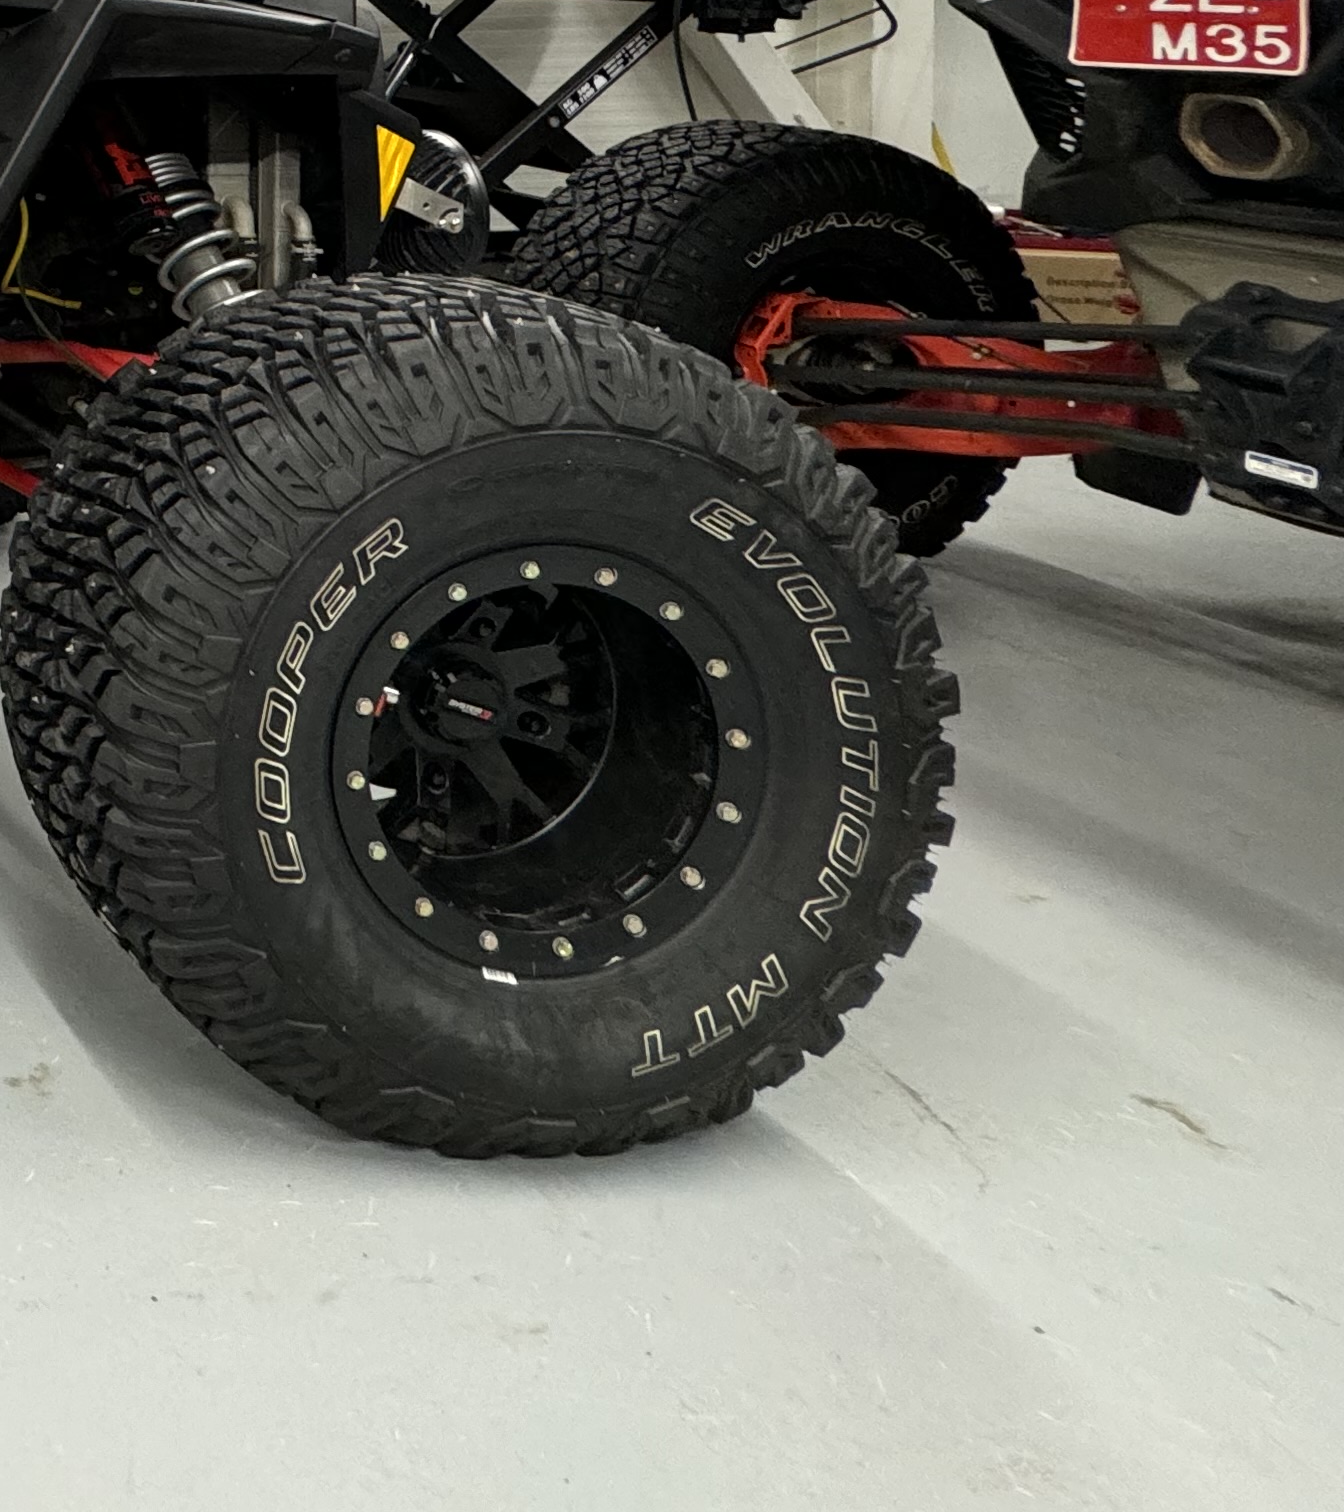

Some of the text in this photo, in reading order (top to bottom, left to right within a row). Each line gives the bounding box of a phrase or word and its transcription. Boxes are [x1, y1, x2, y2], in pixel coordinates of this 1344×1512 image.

[1151, 21, 1292, 66] M35
[744, 211, 996, 313] WRANGLER
[254, 516, 411, 886] COOPER
[630, 496, 882, 1078] EVOLUTION MTT
